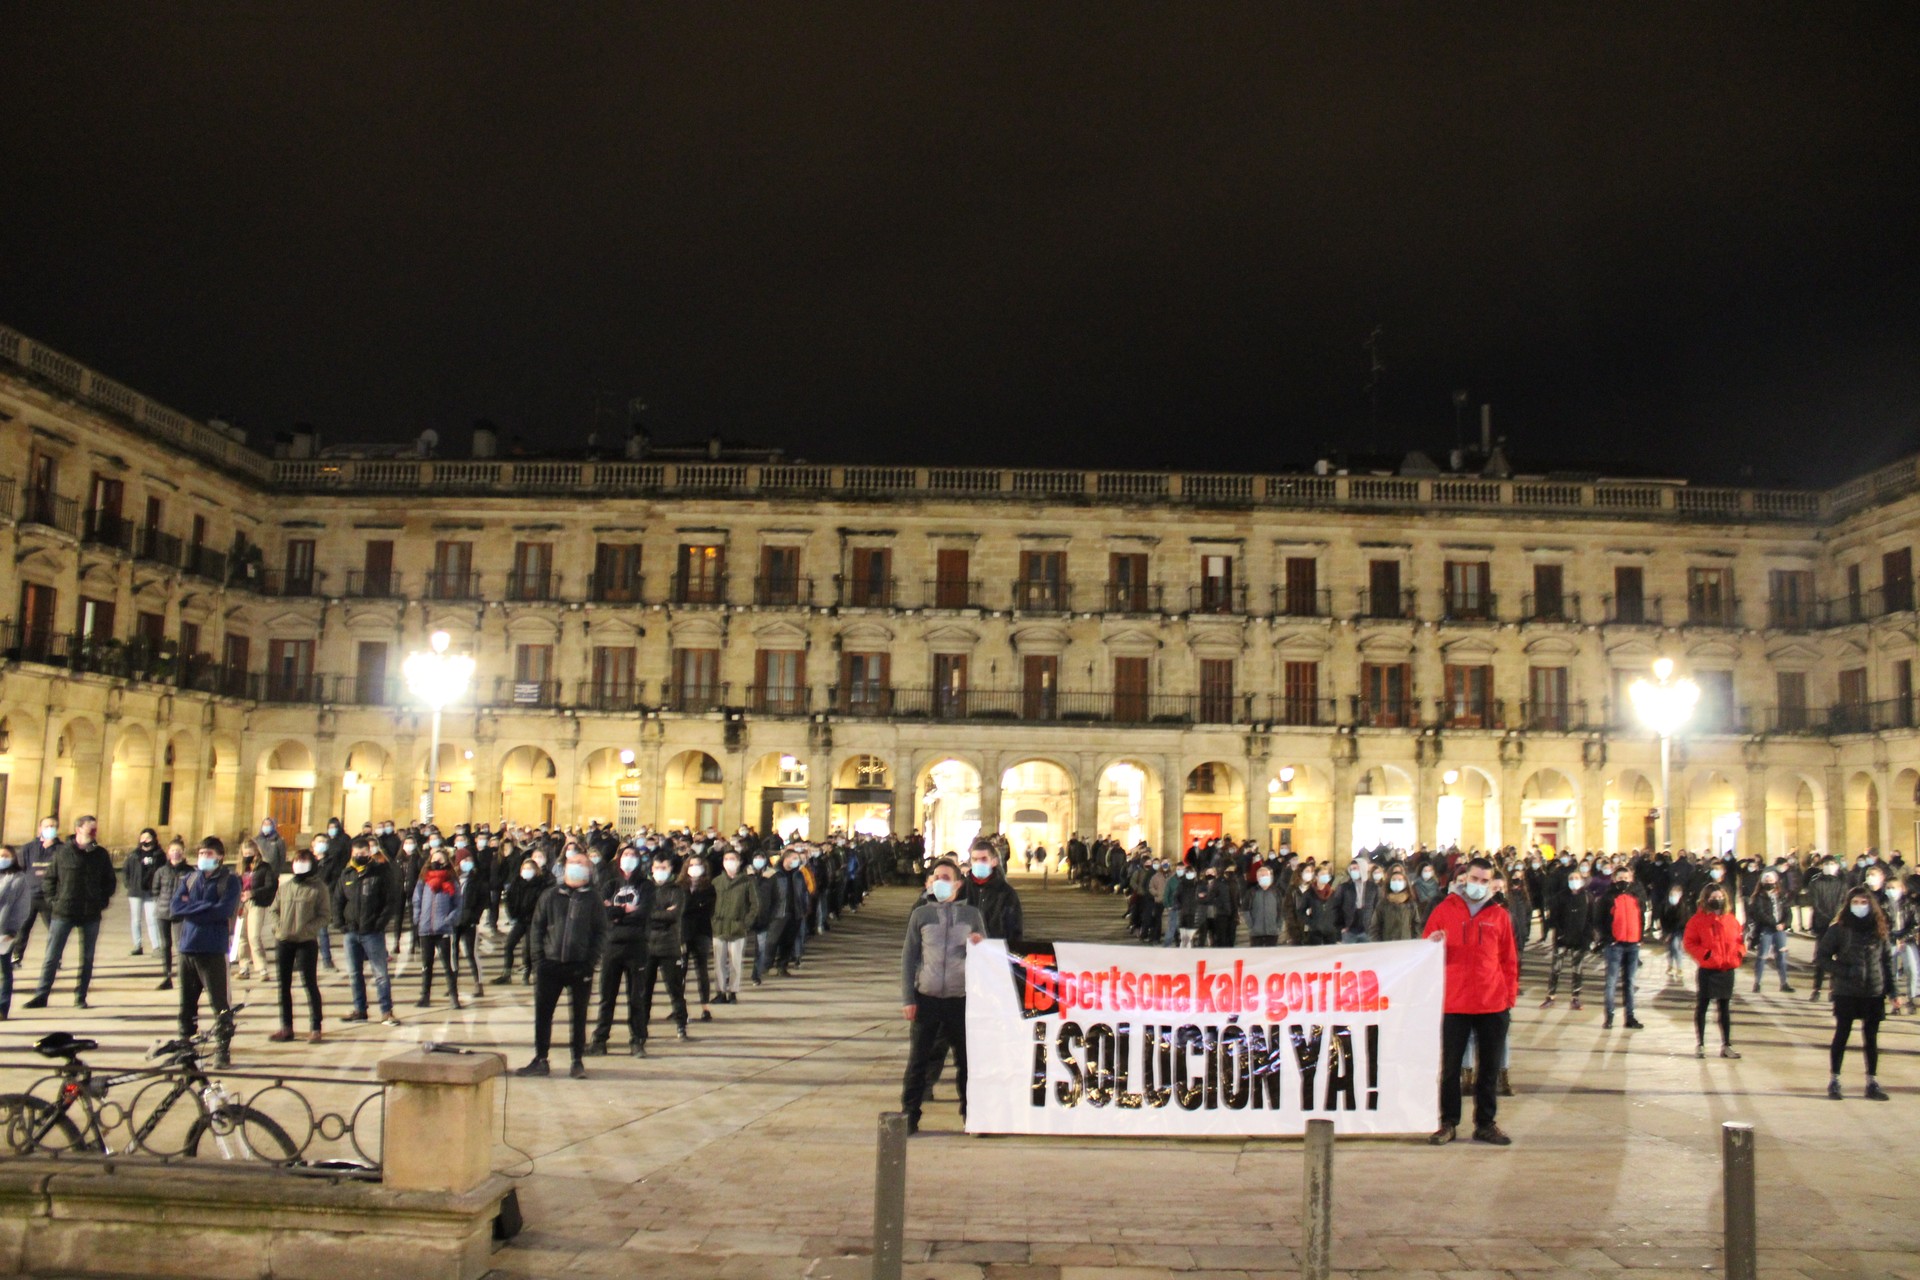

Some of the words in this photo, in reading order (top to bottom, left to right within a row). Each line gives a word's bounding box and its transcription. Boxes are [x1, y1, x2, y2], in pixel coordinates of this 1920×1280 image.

[1023, 953, 1056, 1011] 15
[1058, 965, 1191, 1019] pertsona
[1196, 959, 1259, 1013] kale
[1265, 962, 1389, 1022] gorrian.
[1289, 1023, 1378, 1111] YA!
